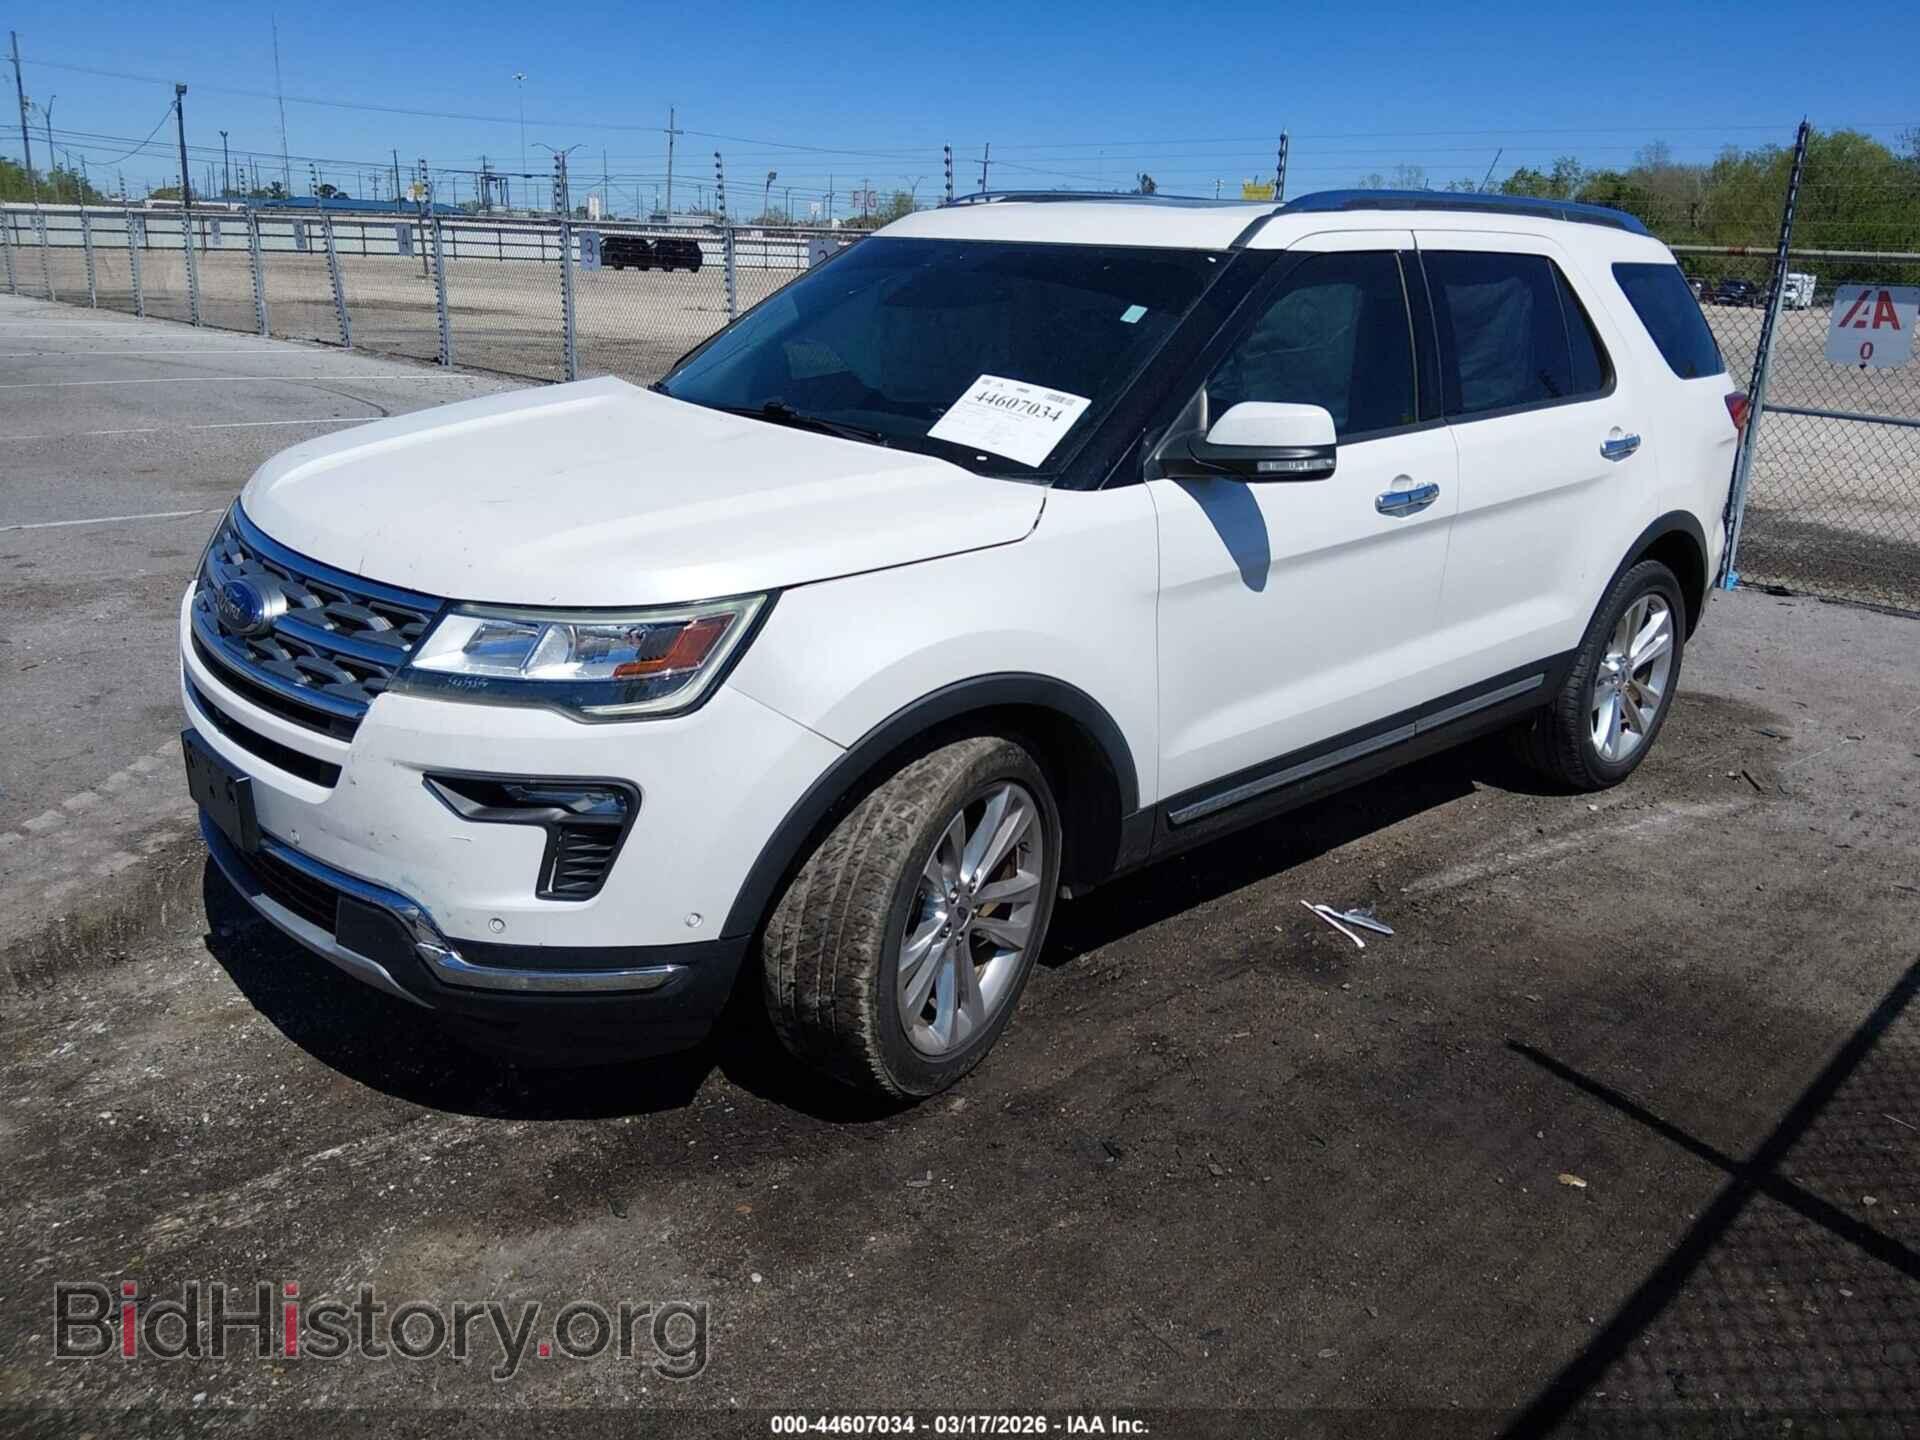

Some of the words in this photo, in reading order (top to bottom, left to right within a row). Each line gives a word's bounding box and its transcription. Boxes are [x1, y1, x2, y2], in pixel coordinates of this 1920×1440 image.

[585, 238, 594, 263] 3
[1860, 342, 1874, 360] 0
[975, 390, 1062, 423] 44607034
